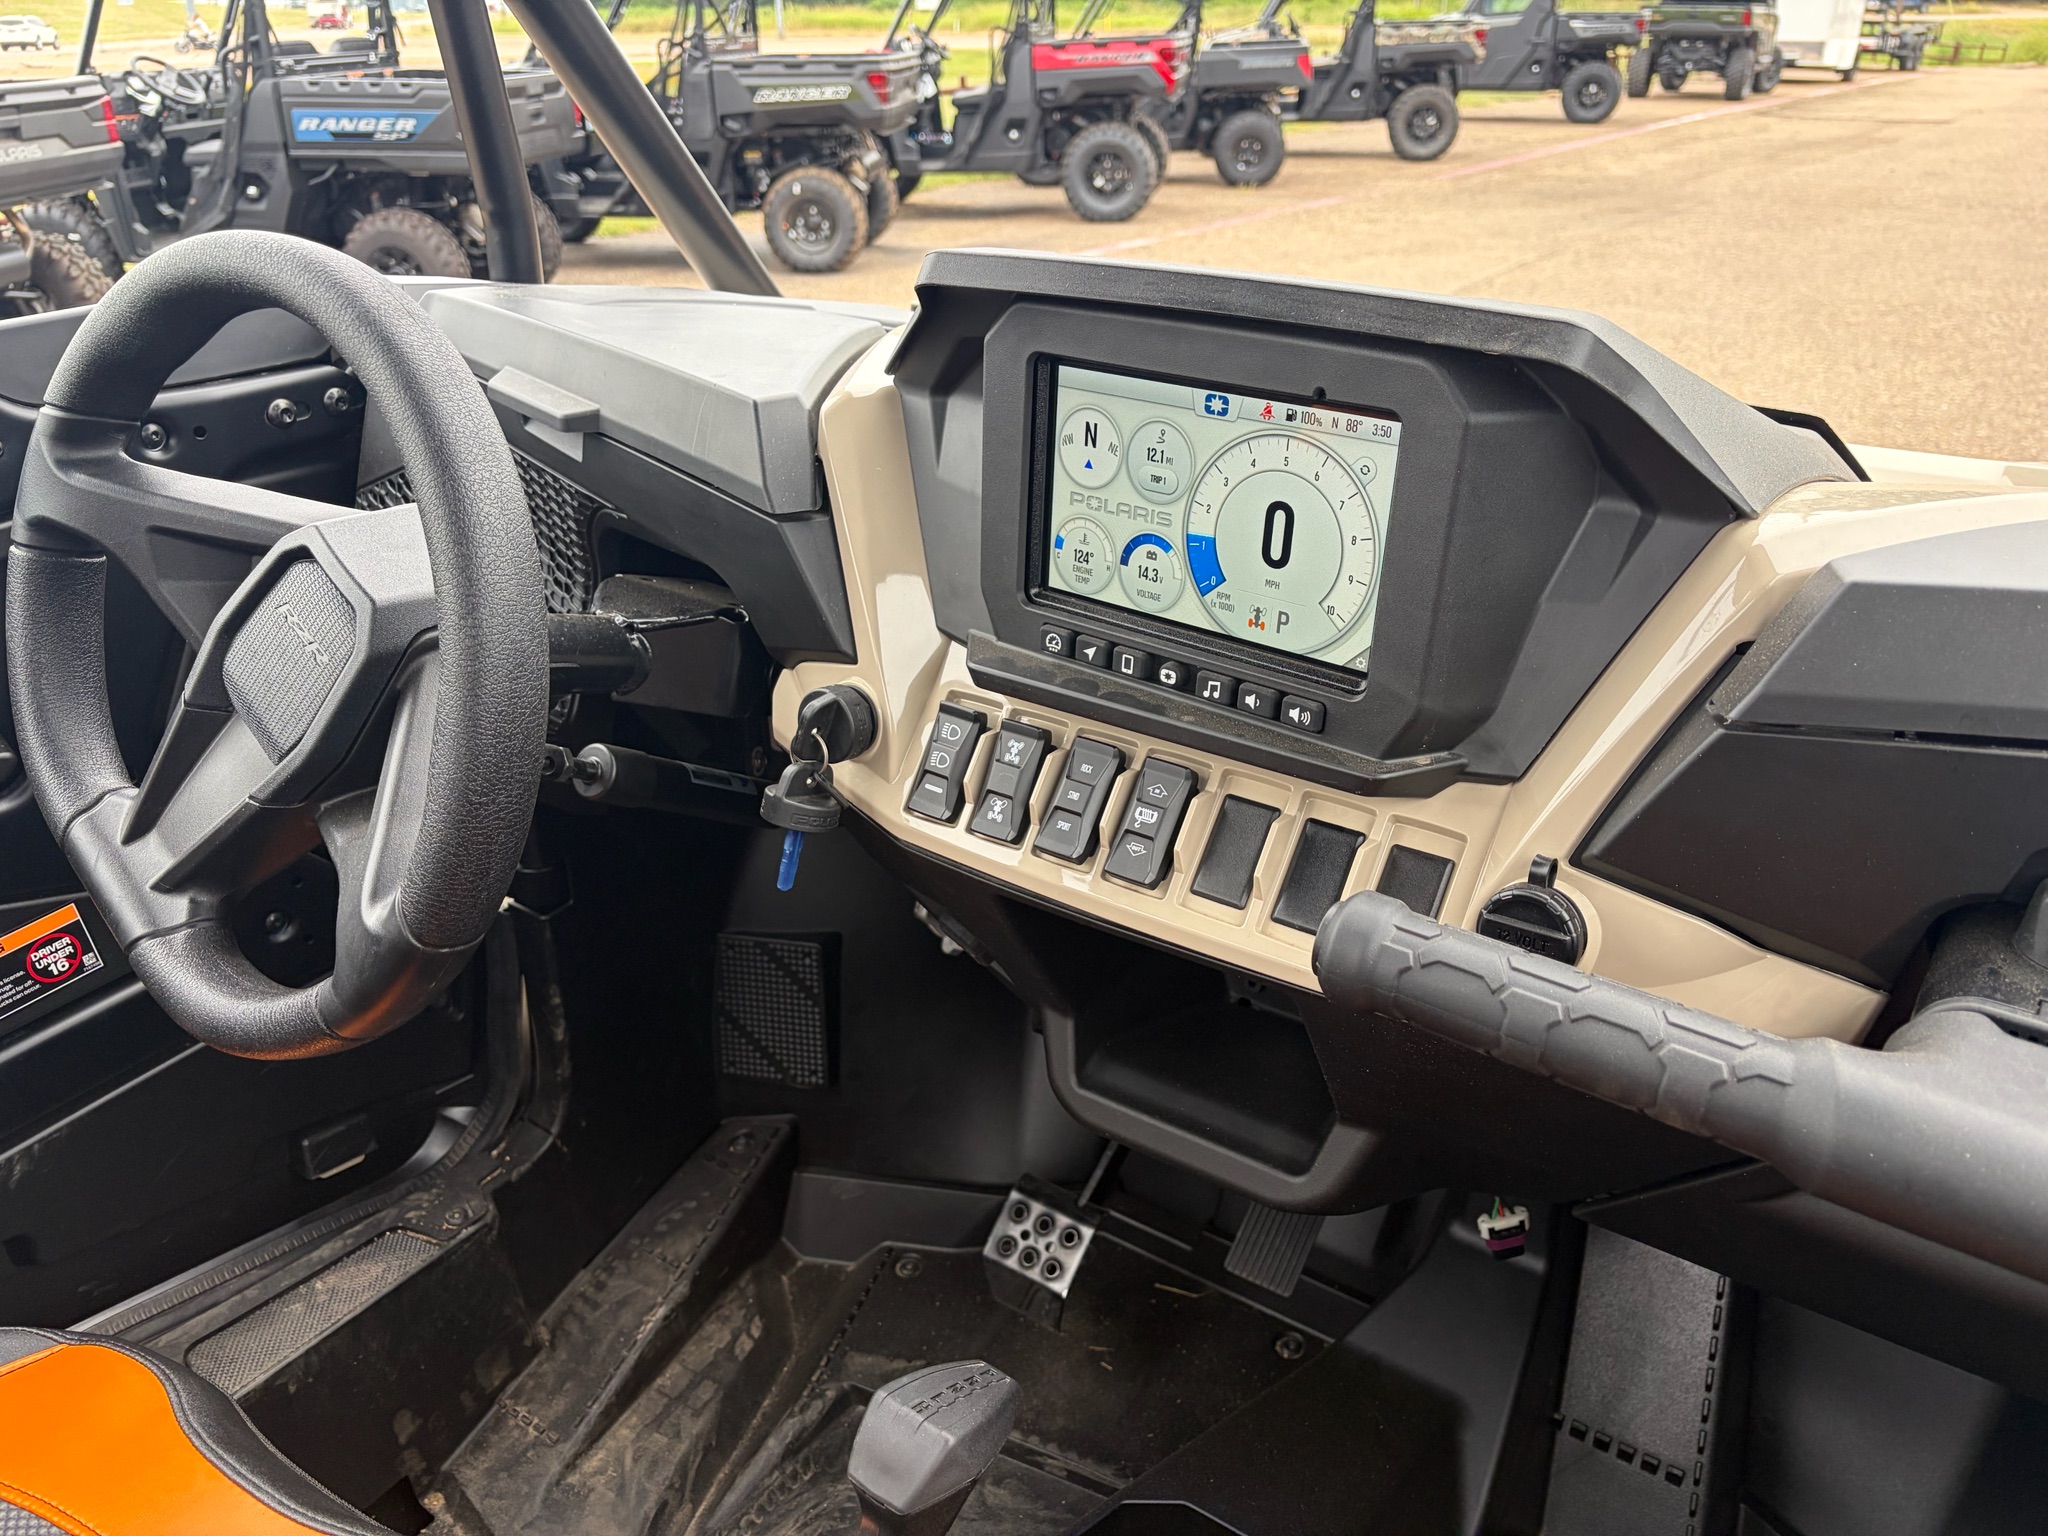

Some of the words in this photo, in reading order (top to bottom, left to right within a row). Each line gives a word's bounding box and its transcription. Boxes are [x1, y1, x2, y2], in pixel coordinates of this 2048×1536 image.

[298, 116, 417, 132] RANGER
[1300, 411, 1322, 427] 100%
[1332, 416, 1338, 429] N
[1346, 418, 1364, 433] 88°
[1372, 424, 1392, 438] 3:50
[1084, 421, 1098, 448] N
[1146, 447, 1164, 464] 12.1
[1166, 456, 1174, 466] MI
[1284, 456, 1289, 466] 5
[1250, 458, 1256, 468] 4
[1150, 474, 1162, 484] TRIP
[1224, 477, 1229, 487] 3
[1314, 471, 1320, 482] 6
[1070, 491, 1172, 528] POLARIS
[1206, 504, 1212, 514] 2
[1339, 501, 1345, 510] 7
[1262, 501, 1294, 570] 0
[1351, 536, 1357, 546] 8
[1074, 548, 1094, 565] 124°
[1072, 564, 1094, 576] ENGINE
[1138, 565, 1158, 582] 14.3
[1074, 574, 1090, 585] TEMP
[1210, 576, 1216, 586] 0
[1264, 578, 1280, 590] MPH
[1348, 574, 1354, 586] 9
[1136, 588, 1162, 602] VOLTAGE
[1216, 591, 1230, 602] RPM
[1326, 604, 1334, 616] 10
[1276, 610, 1290, 634] P
[275, 602, 329, 664] RZR
[1080, 764, 1093, 774] ROCK
[1056, 820, 1072, 832] SPORT
[1515, 930, 1550, 953] VOLT
[30, 936, 72, 962] DRIVER
[34, 946, 74, 969] UNDER
[48, 958, 70, 976] 16
[2, 970, 26, 984] license.
[16, 984, 24, 992] for
[24, 980, 34, 988] off-
[12, 992, 24, 1001] can
[24, 984, 42, 995] occur.
